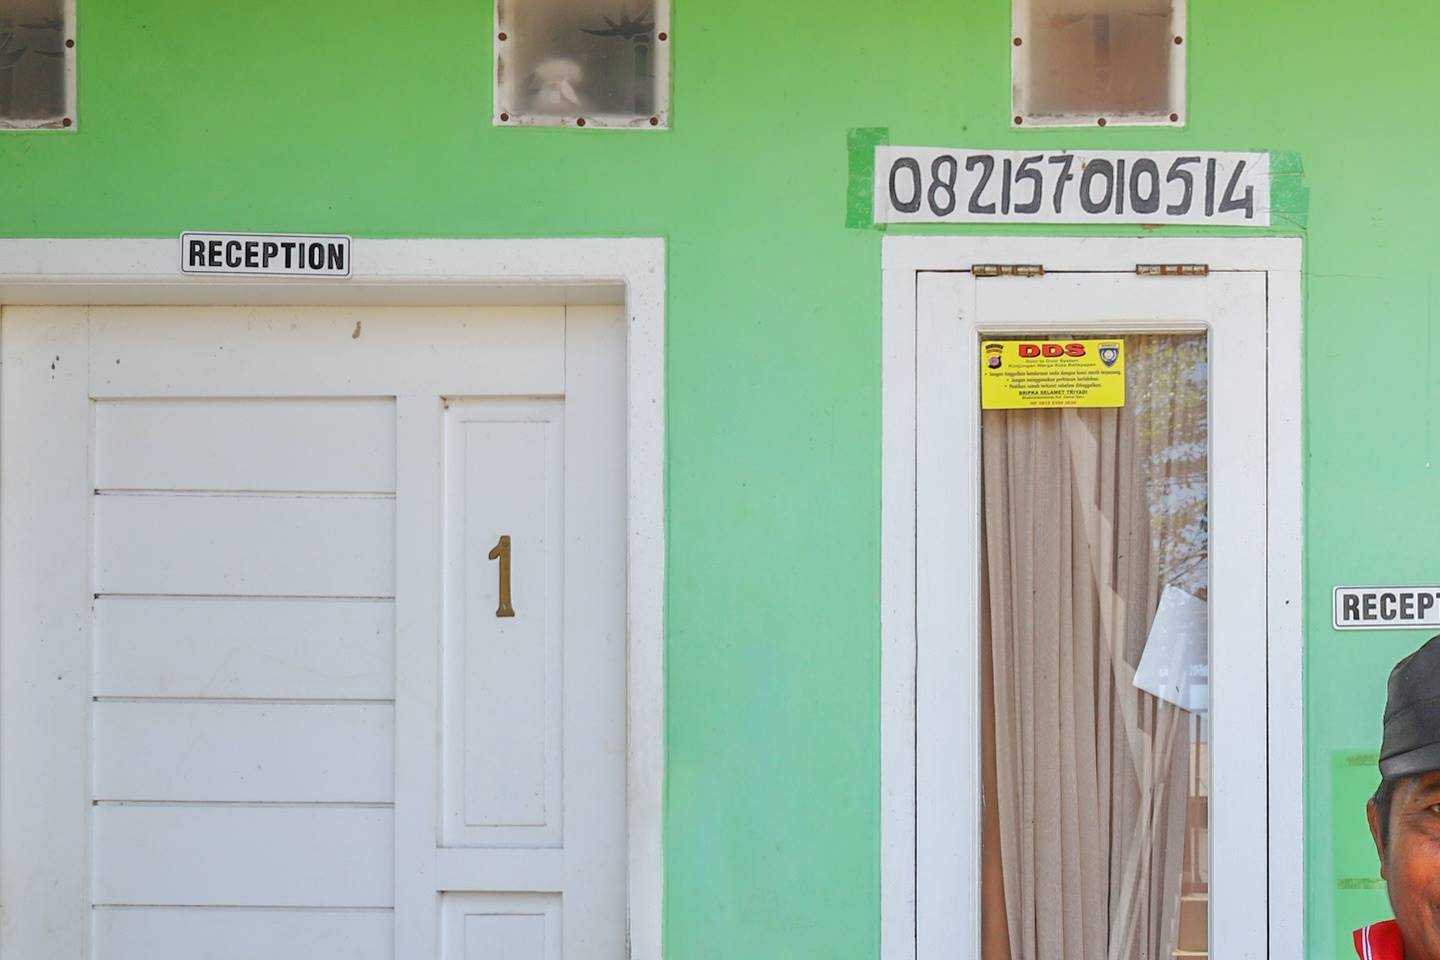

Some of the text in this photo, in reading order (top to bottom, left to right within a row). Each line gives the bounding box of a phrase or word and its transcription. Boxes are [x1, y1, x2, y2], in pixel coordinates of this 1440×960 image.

[888, 154, 1254, 218] 082157010514
[189, 240, 344, 270] RECEPTION
[1018, 343, 1086, 358] DDS
[488, 535, 516, 617] 1
